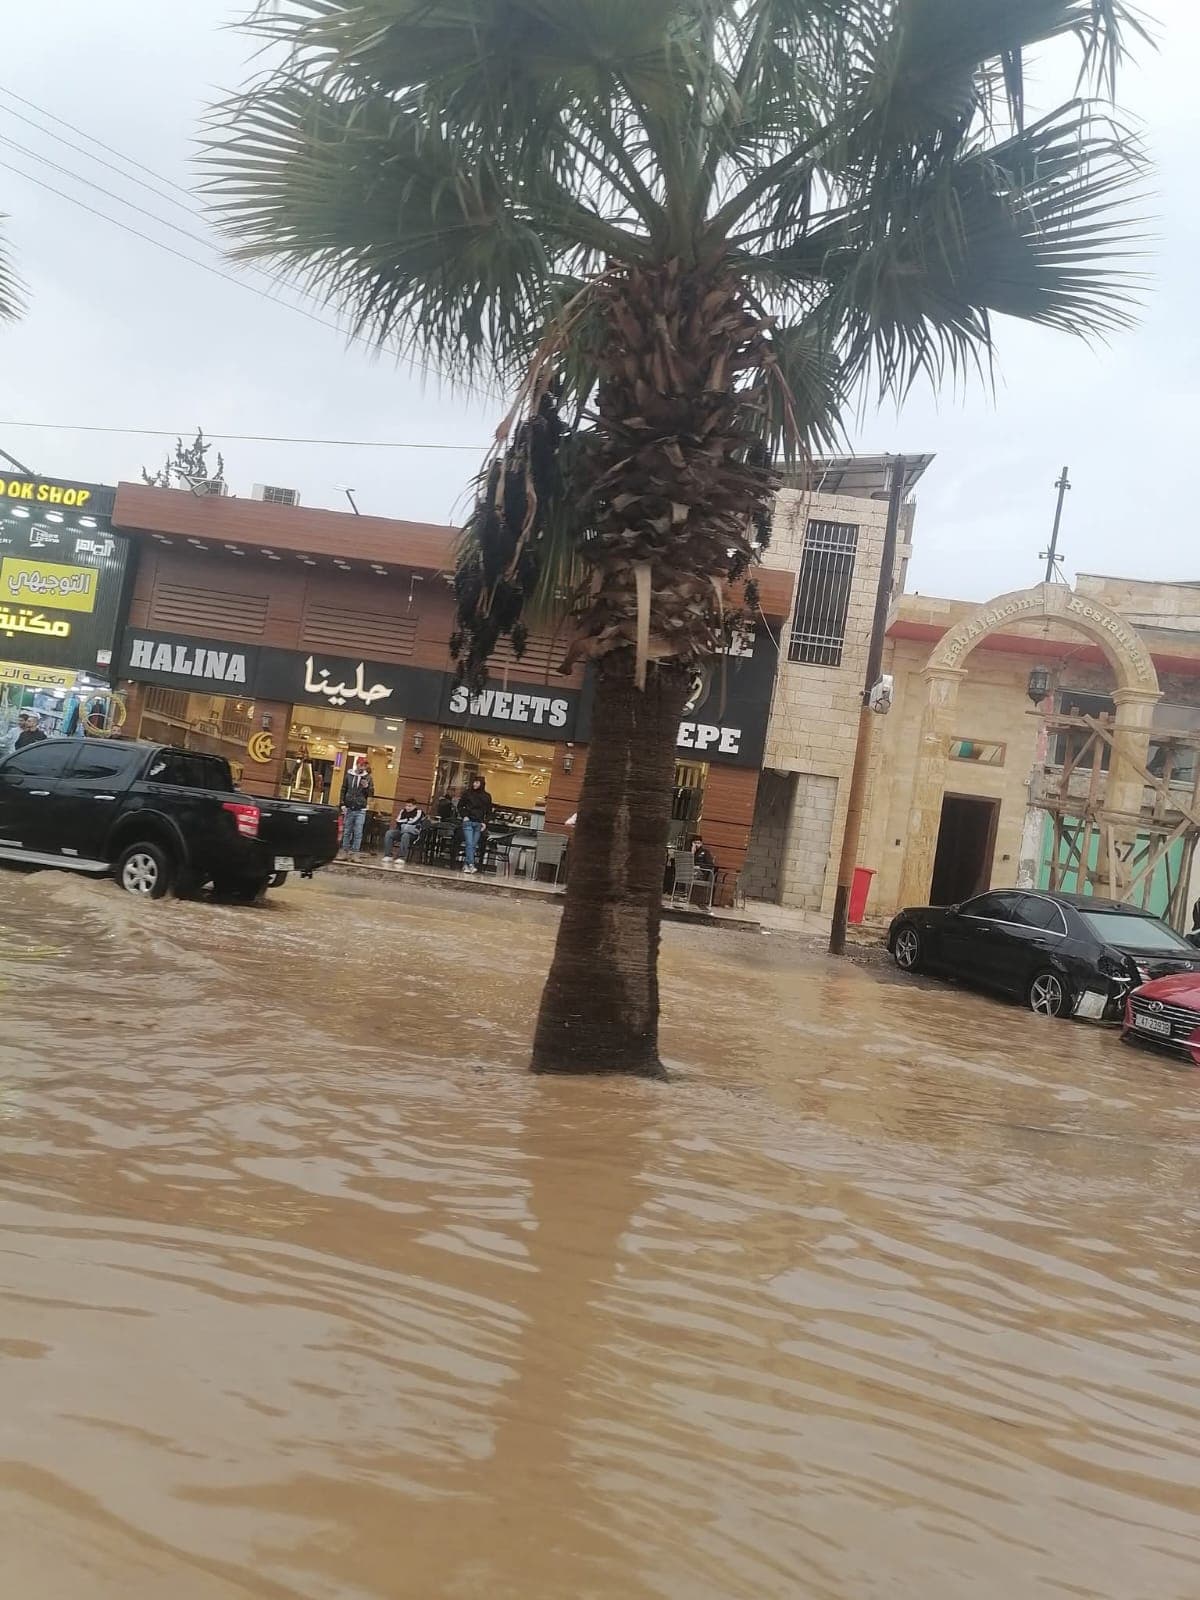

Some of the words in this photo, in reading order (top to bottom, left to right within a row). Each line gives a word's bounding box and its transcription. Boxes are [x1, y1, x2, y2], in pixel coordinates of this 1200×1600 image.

[37, 485, 90, 506] SHOP
[8, 571, 91, 596] التوجيهي
[941, 636, 969, 668] Bab
[1066, 598, 1150, 682] Restaurant
[129, 640, 247, 683] HALINA
[449, 686, 569, 727] SWEETS
